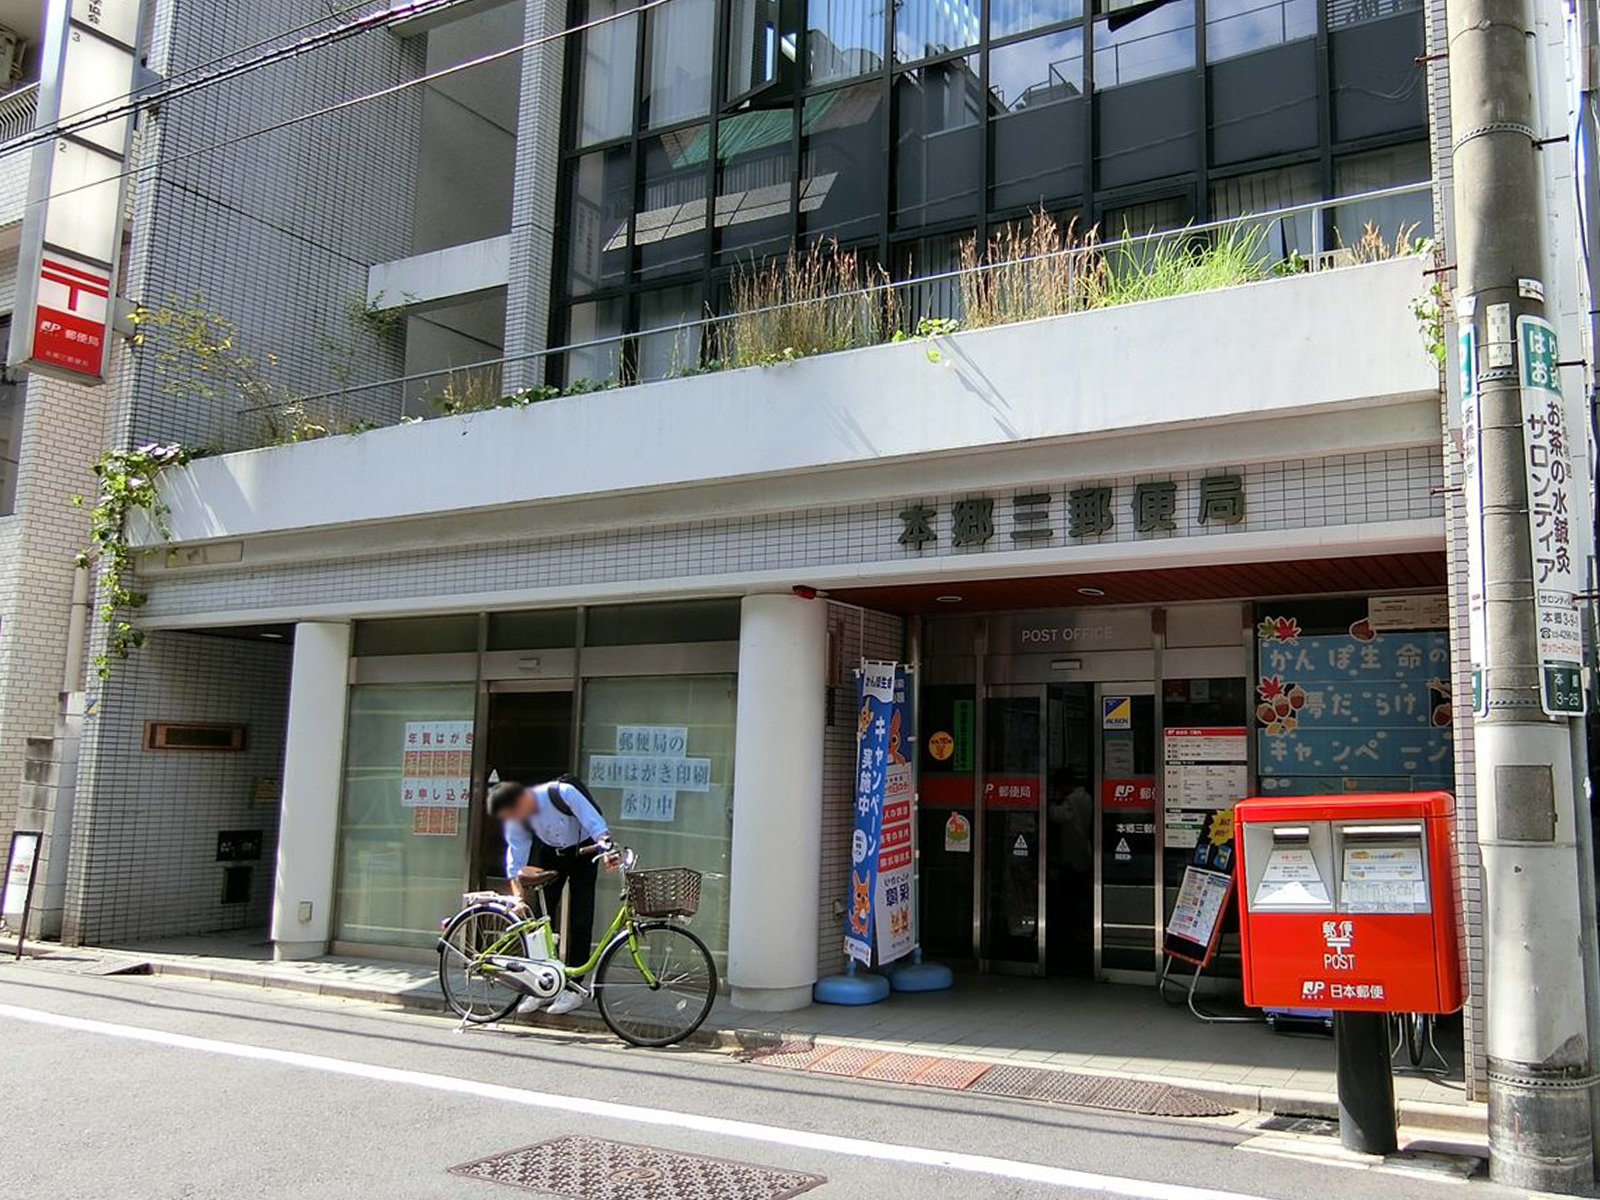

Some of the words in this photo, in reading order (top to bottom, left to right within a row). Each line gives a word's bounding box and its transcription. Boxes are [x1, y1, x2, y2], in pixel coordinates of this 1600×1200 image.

[72, 31, 81, 42] 3
[58, 142, 68, 153] 2
[65, 329, 99, 347] 郵便局
[1528, 413, 1555, 583] サロンティア
[898, 475, 1246, 550] 本郷三郵便局
[1021, 629, 1058, 643] POST
[1062, 626, 1114, 641] OFFICE
[1270, 643, 1448, 672] かんぽ生命の
[1306, 691, 1417, 718] 夢だらけ
[408, 732, 475, 746] 年賀はがき
[618, 731, 684, 752] 郵便局の
[1270, 730, 1448, 762] キャンペーン
[591, 761, 708, 785] 喪中はがき印刷
[858, 747, 873, 817] 実施中
[404, 787, 471, 801] お申し込み
[868, 715, 886, 856] キャンペーン
[998, 785, 1031, 799] 郵便局
[623, 793, 672, 815] 承り中
[1322, 920, 1354, 939] 郵便
[1323, 954, 1355, 970] POST
[1330, 984, 1384, 999] 日本郵便
